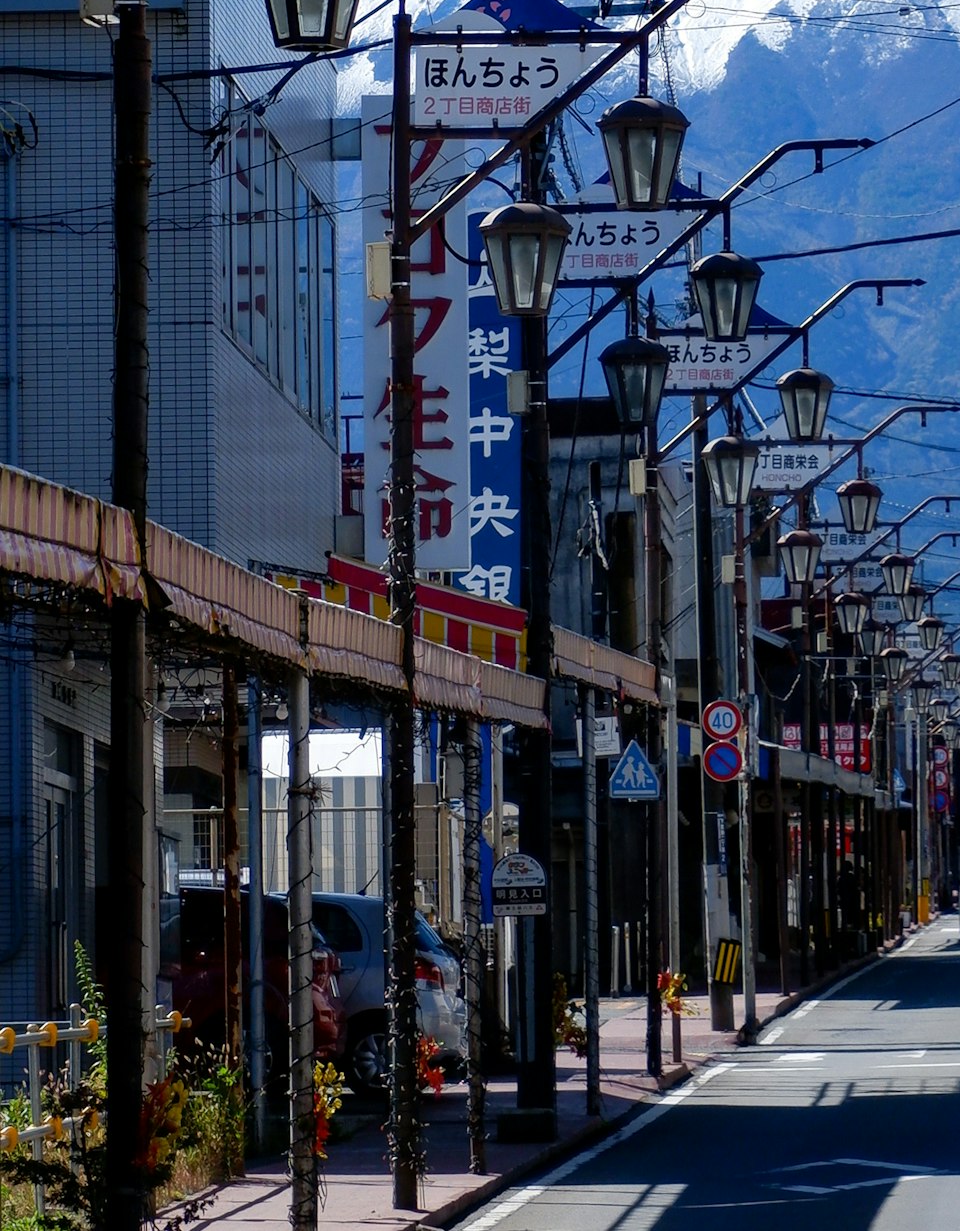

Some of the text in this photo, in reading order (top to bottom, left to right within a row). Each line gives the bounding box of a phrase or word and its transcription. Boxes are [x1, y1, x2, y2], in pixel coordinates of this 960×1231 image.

[424, 56, 560, 89] ほんちょう
[423, 96, 531, 116] 2丁目商店街
[563, 252, 638, 268] 丁目商店街
[666, 343, 751, 364] ほんちょう
[459, 248, 519, 605] 梨中央銀
[761, 474, 802, 482] HONCHO
[712, 712, 733, 729] 40
[496, 889, 542, 899] 明見入口
